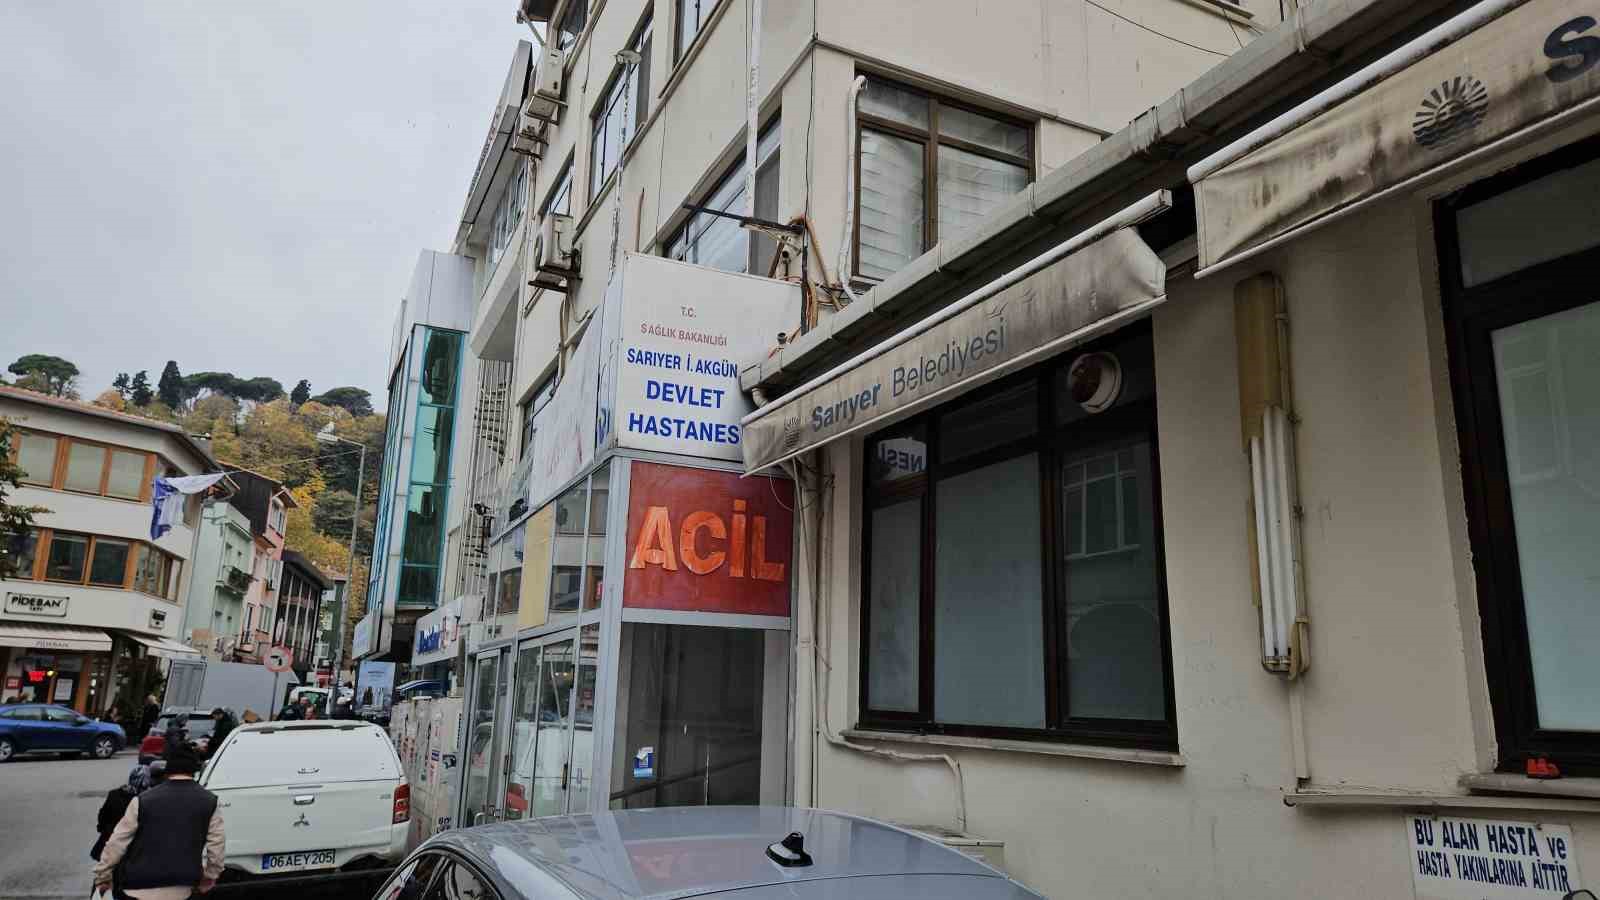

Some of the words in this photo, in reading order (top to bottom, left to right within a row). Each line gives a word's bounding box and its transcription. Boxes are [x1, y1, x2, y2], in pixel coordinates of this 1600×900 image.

[641, 322, 676, 339] SAĞLIK
[678, 330, 728, 347] BAKANLIĞI
[626, 348, 681, 370] SARIYER
[811, 383, 881, 432] Sarıyer
[892, 317, 1006, 398] Belediyesi
[646, 379, 725, 409] DEVLET
[628, 412, 740, 445] HASTANES
[629, 499, 785, 582] ACİL
[1414, 818, 1435, 847] BU
[1442, 821, 1480, 850] ALAN
[1486, 824, 1540, 857] HASTA
[1546, 836, 1568, 859] ve
[1417, 850, 1451, 878] HASTA
[1453, 854, 1528, 888] YAKINLARINA
[1532, 859, 1571, 892] AİTTİR
